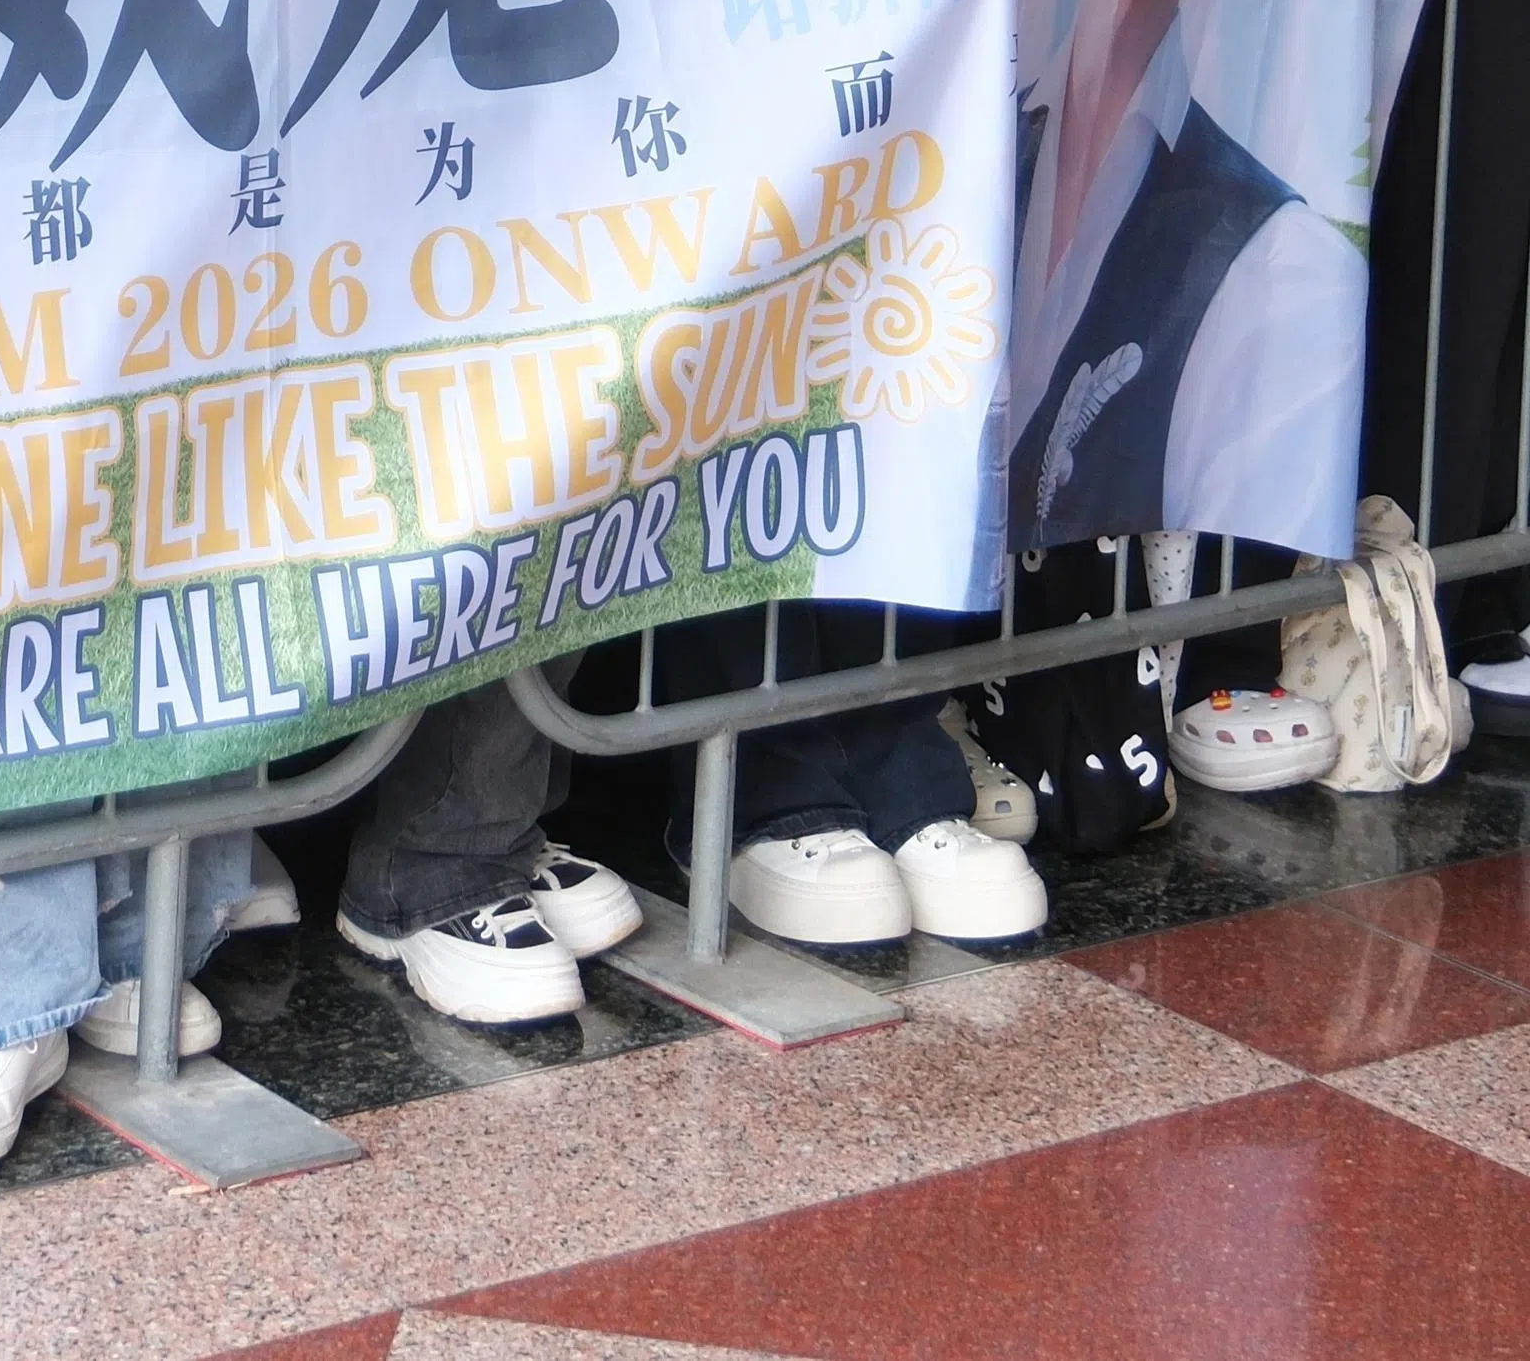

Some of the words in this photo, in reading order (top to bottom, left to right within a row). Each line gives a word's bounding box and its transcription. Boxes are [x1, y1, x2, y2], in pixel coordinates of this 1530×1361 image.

[116, 241, 369, 379] 2026
[408, 129, 946, 323] ONWARD
[130, 349, 378, 585] LIKE
[382, 301, 638, 547] THE
[630, 259, 820, 477] SUN
[131, 566, 307, 746] ALL
[327, 529, 526, 701] HERE
[538, 475, 678, 626] FOR
[698, 425, 864, 574] YOU
